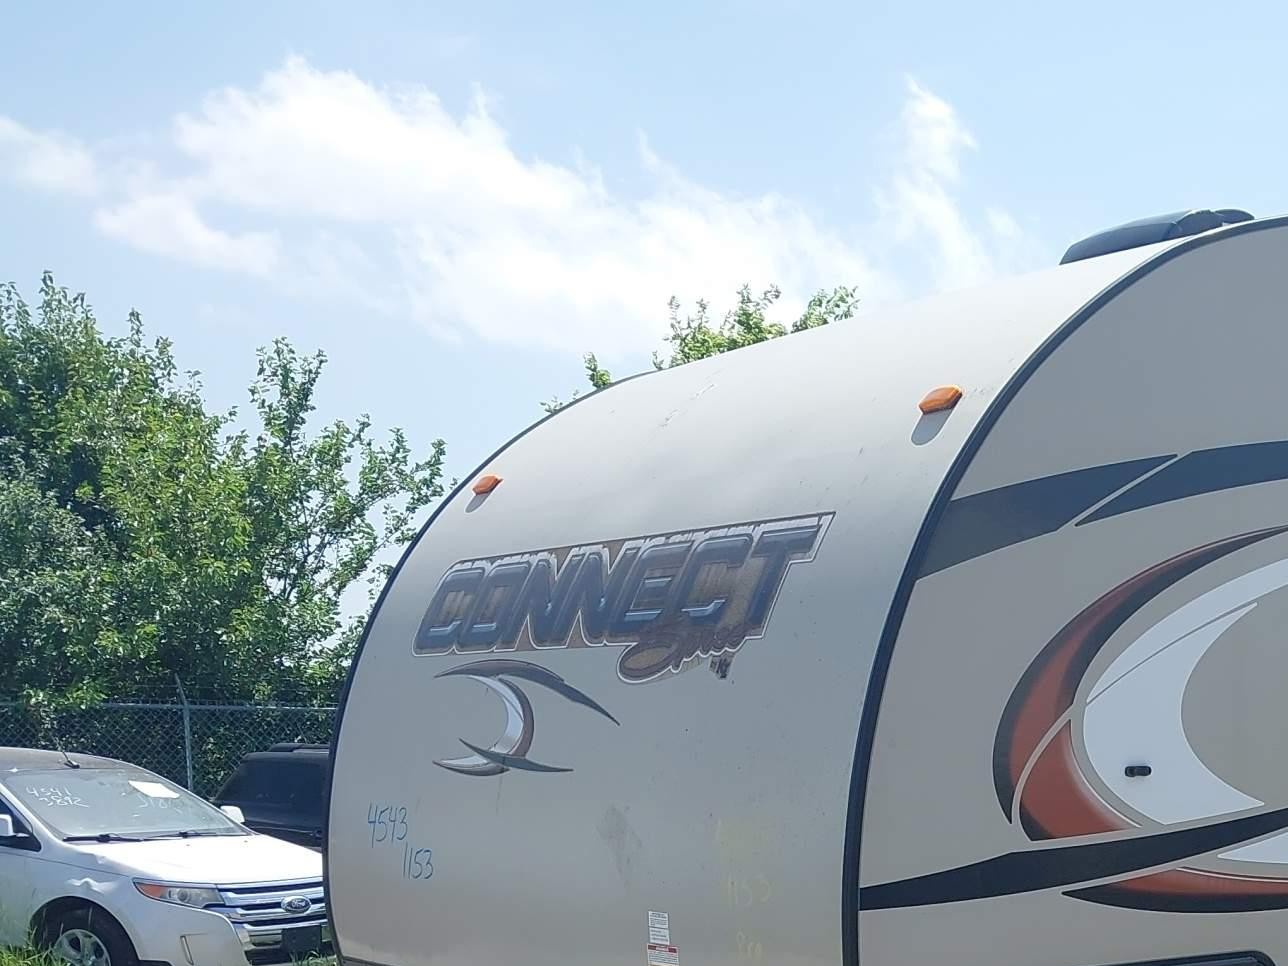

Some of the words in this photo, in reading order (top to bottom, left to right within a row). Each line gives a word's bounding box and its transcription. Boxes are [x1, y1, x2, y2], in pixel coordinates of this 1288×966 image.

[414, 517, 830, 653] CONNECT
[367, 802, 408, 848] 4543
[403, 842, 434, 880] 1153
